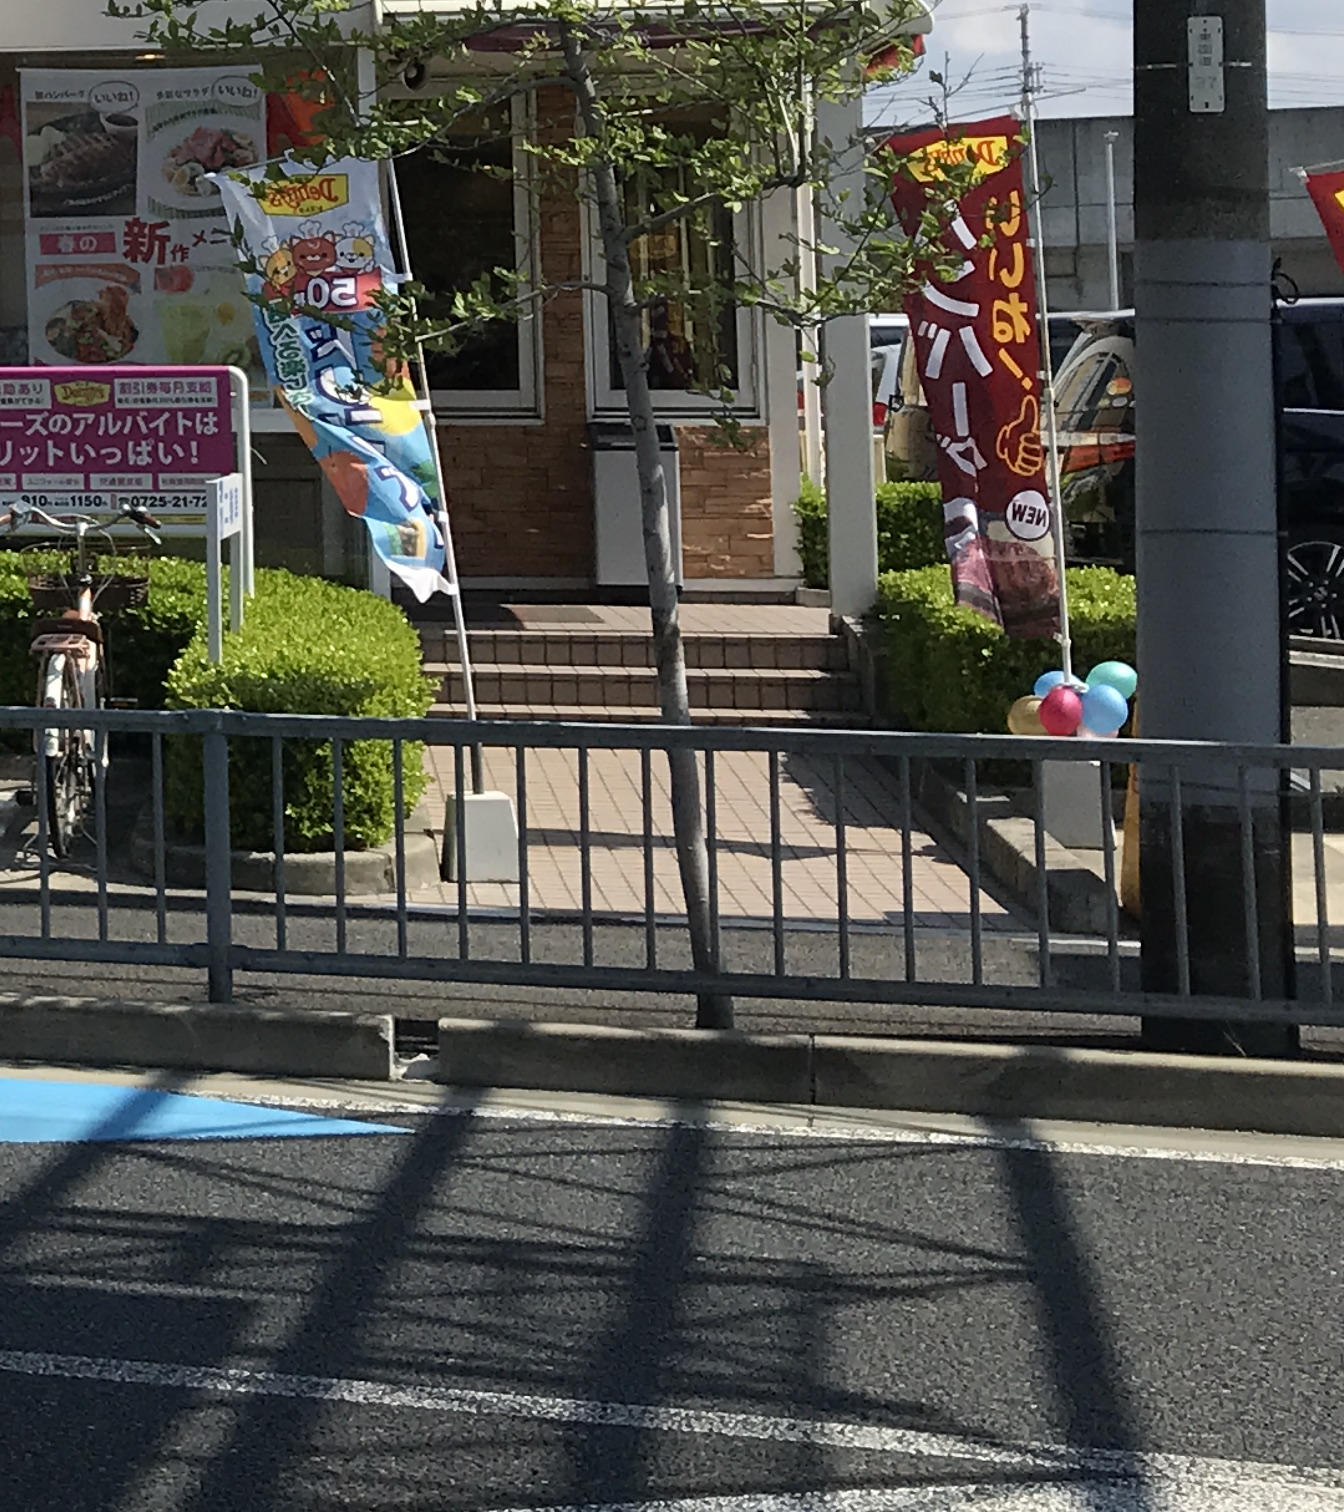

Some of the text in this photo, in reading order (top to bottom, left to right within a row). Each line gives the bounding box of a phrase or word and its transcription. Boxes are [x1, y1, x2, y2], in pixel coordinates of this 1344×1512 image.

[94, 91, 134, 104] いいね!
[218, 85, 258, 99] いいね!
[120, 381, 211, 394] 割引券毎月支給
